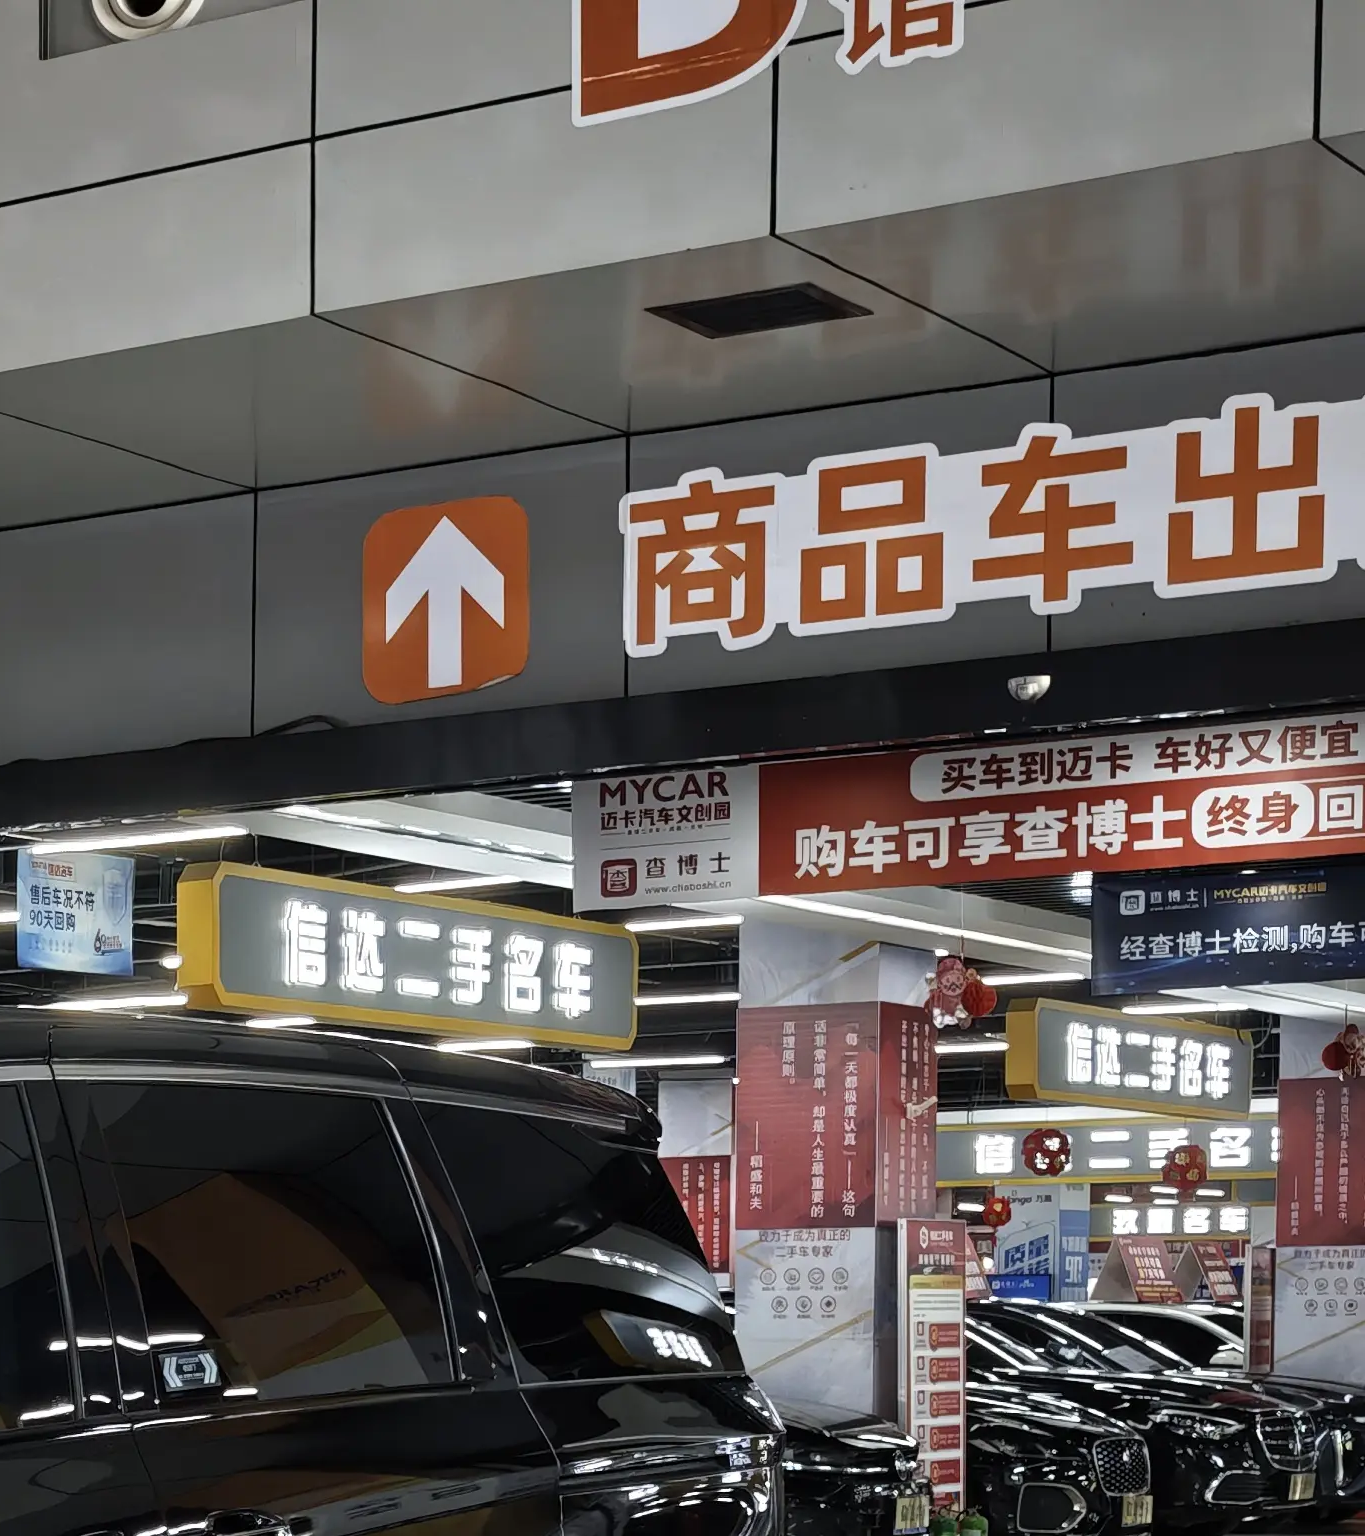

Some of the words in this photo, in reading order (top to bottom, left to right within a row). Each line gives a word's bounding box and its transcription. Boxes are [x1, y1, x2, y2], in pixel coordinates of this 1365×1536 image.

[628, 405, 1326, 647] 商品车出
[940, 741, 1134, 793] 买车到迈卡
[1154, 722, 1359, 774] 车好又便宜
[599, 771, 730, 808] MYCAR
[600, 801, 731, 831] 迈卡汽车文创园
[645, 851, 731, 879] 查博士
[30, 884, 95, 911] 售后车况不符
[29, 910, 76, 932] 90天回购
[282, 898, 594, 1019] 信达二手名车
[974, 1127, 1281, 1177] 信二手名
